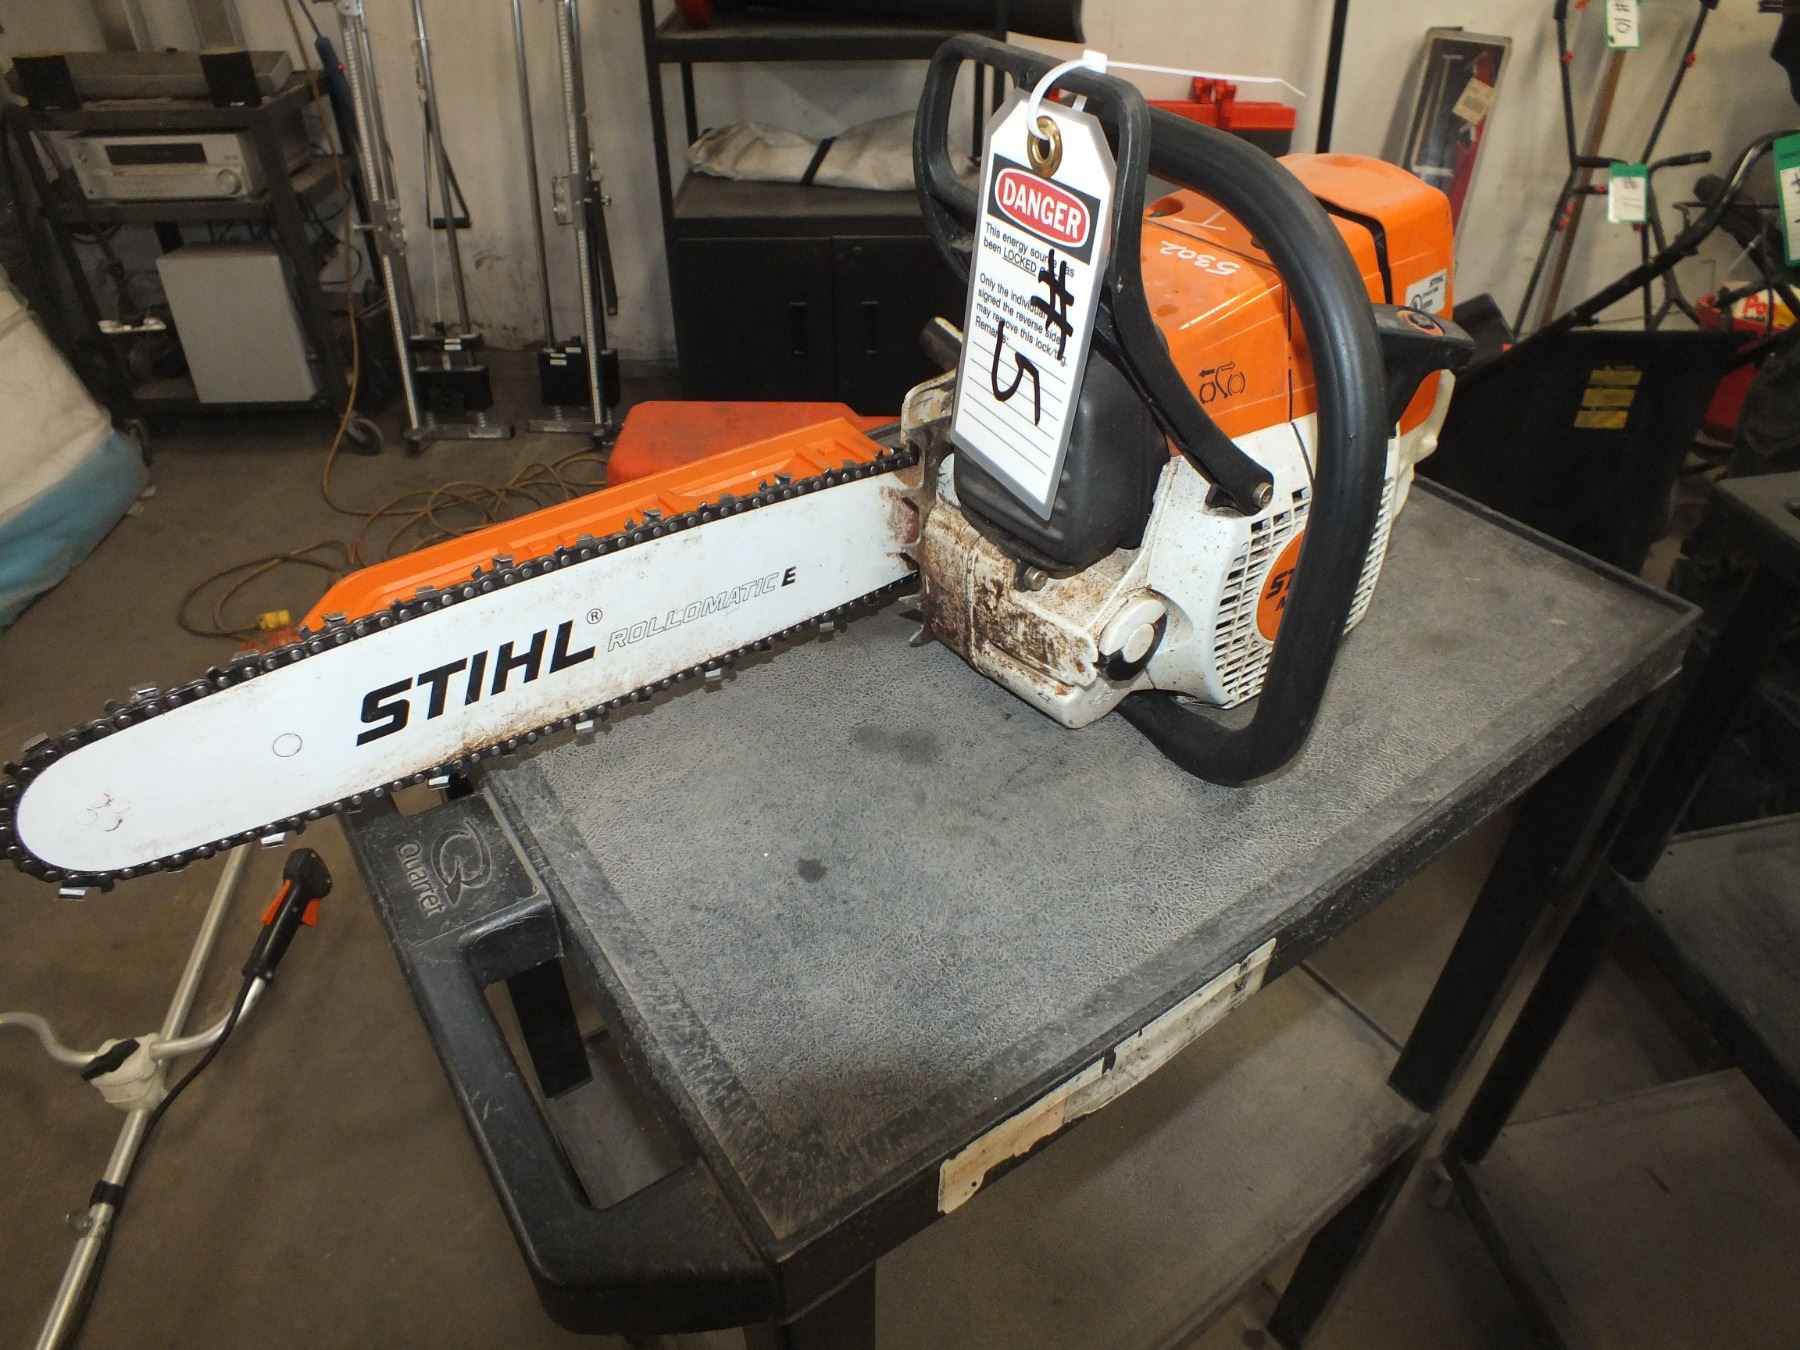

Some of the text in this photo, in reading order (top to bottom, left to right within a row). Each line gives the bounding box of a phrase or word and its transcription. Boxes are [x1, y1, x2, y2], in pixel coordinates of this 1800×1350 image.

[1001, 176, 1083, 241] DANGER
[983, 235, 1002, 255] been
[1003, 245, 1037, 274] LOCKED
[985, 221, 1001, 239] This
[1002, 232, 1028, 255] energy
[1030, 246, 1057, 268] soure
[1159, 240, 1241, 276] 5302
[979, 272, 996, 290] Only
[997, 283, 1009, 298] the
[975, 315, 1009, 343] Remars:
[977, 288, 1001, 308] signed
[1003, 301, 1014, 316] the
[1016, 310, 1043, 334] reverse
[976, 302, 991, 319] may
[1020, 328, 1033, 344] this
[1035, 336, 1068, 367] lock/tg.
[606, 570, 780, 653] ROLLOMATIC
[781, 565, 797, 588] E
[396, 839, 446, 918] Quartet
